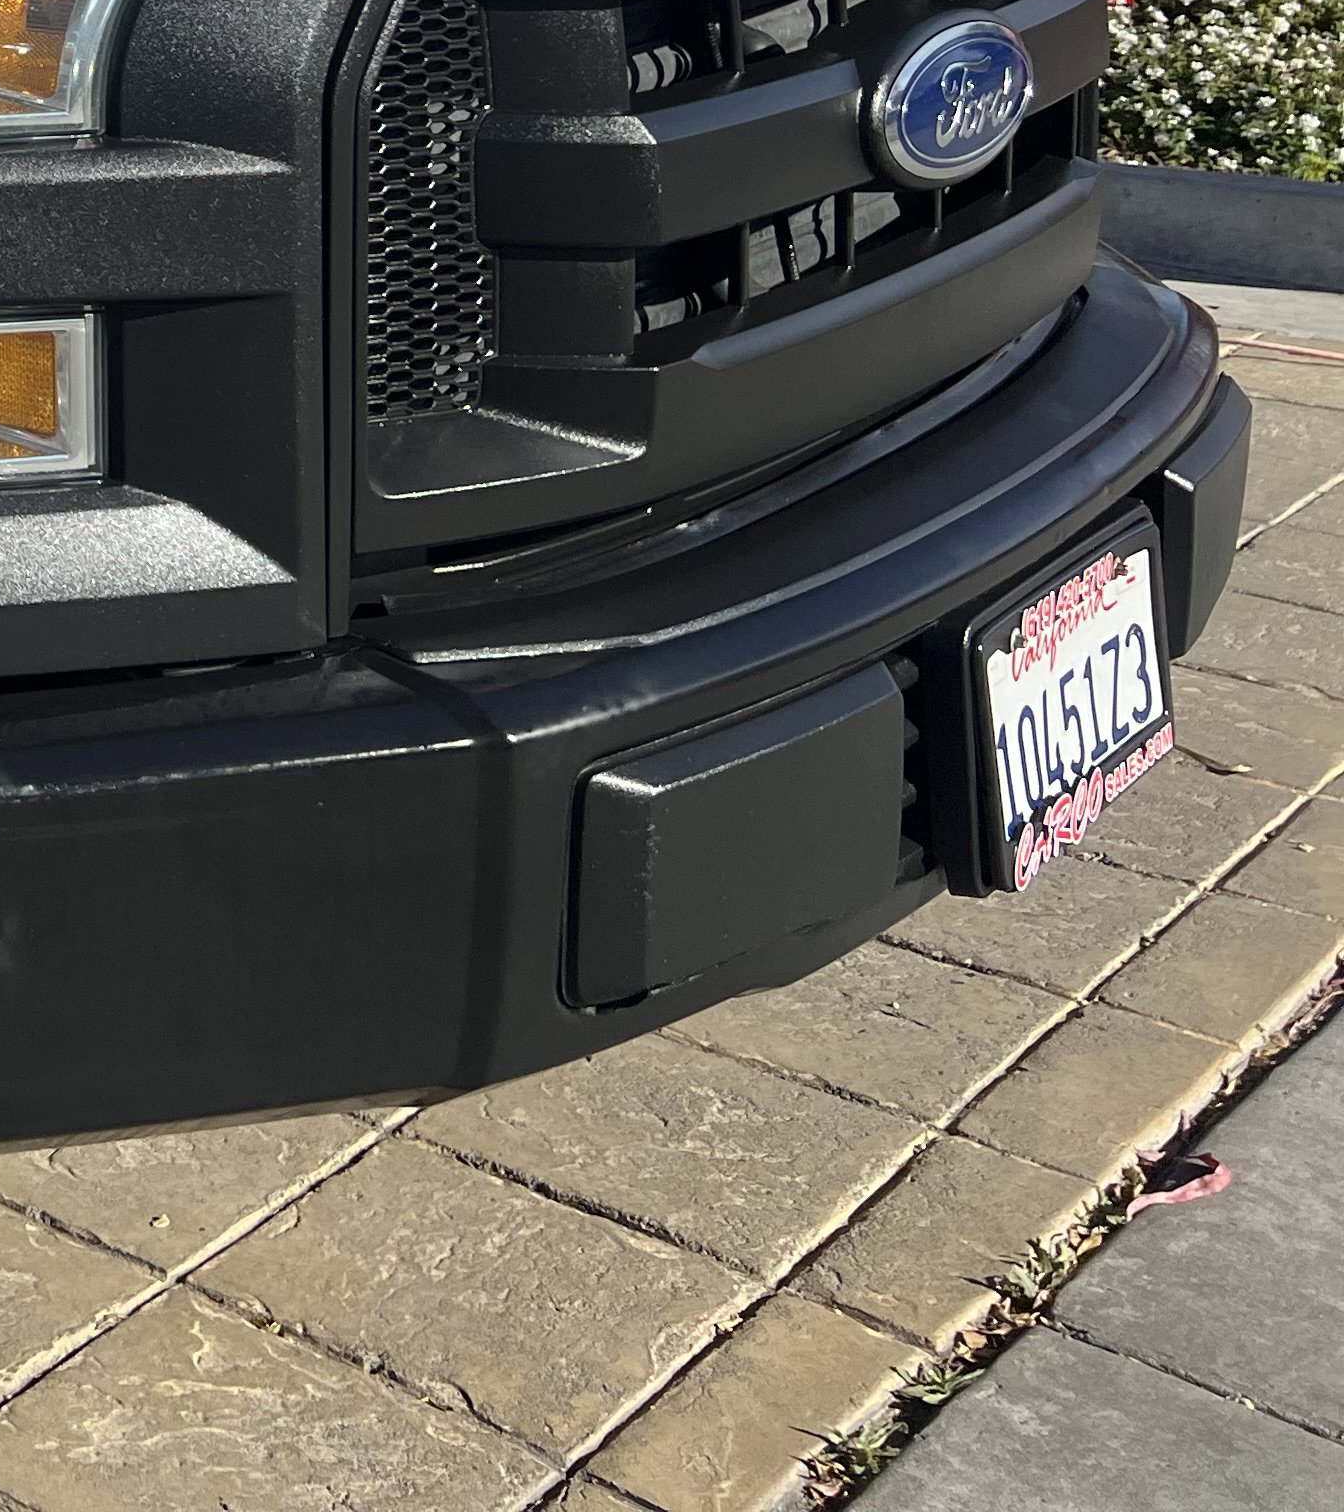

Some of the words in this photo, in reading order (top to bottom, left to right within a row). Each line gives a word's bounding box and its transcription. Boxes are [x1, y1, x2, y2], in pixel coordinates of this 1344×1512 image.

[936, 55, 1013, 148] Ford
[1011, 588, 1118, 681] California
[1015, 767, 1104, 891] CARCO
[1104, 722, 1174, 802] SALES.COM
